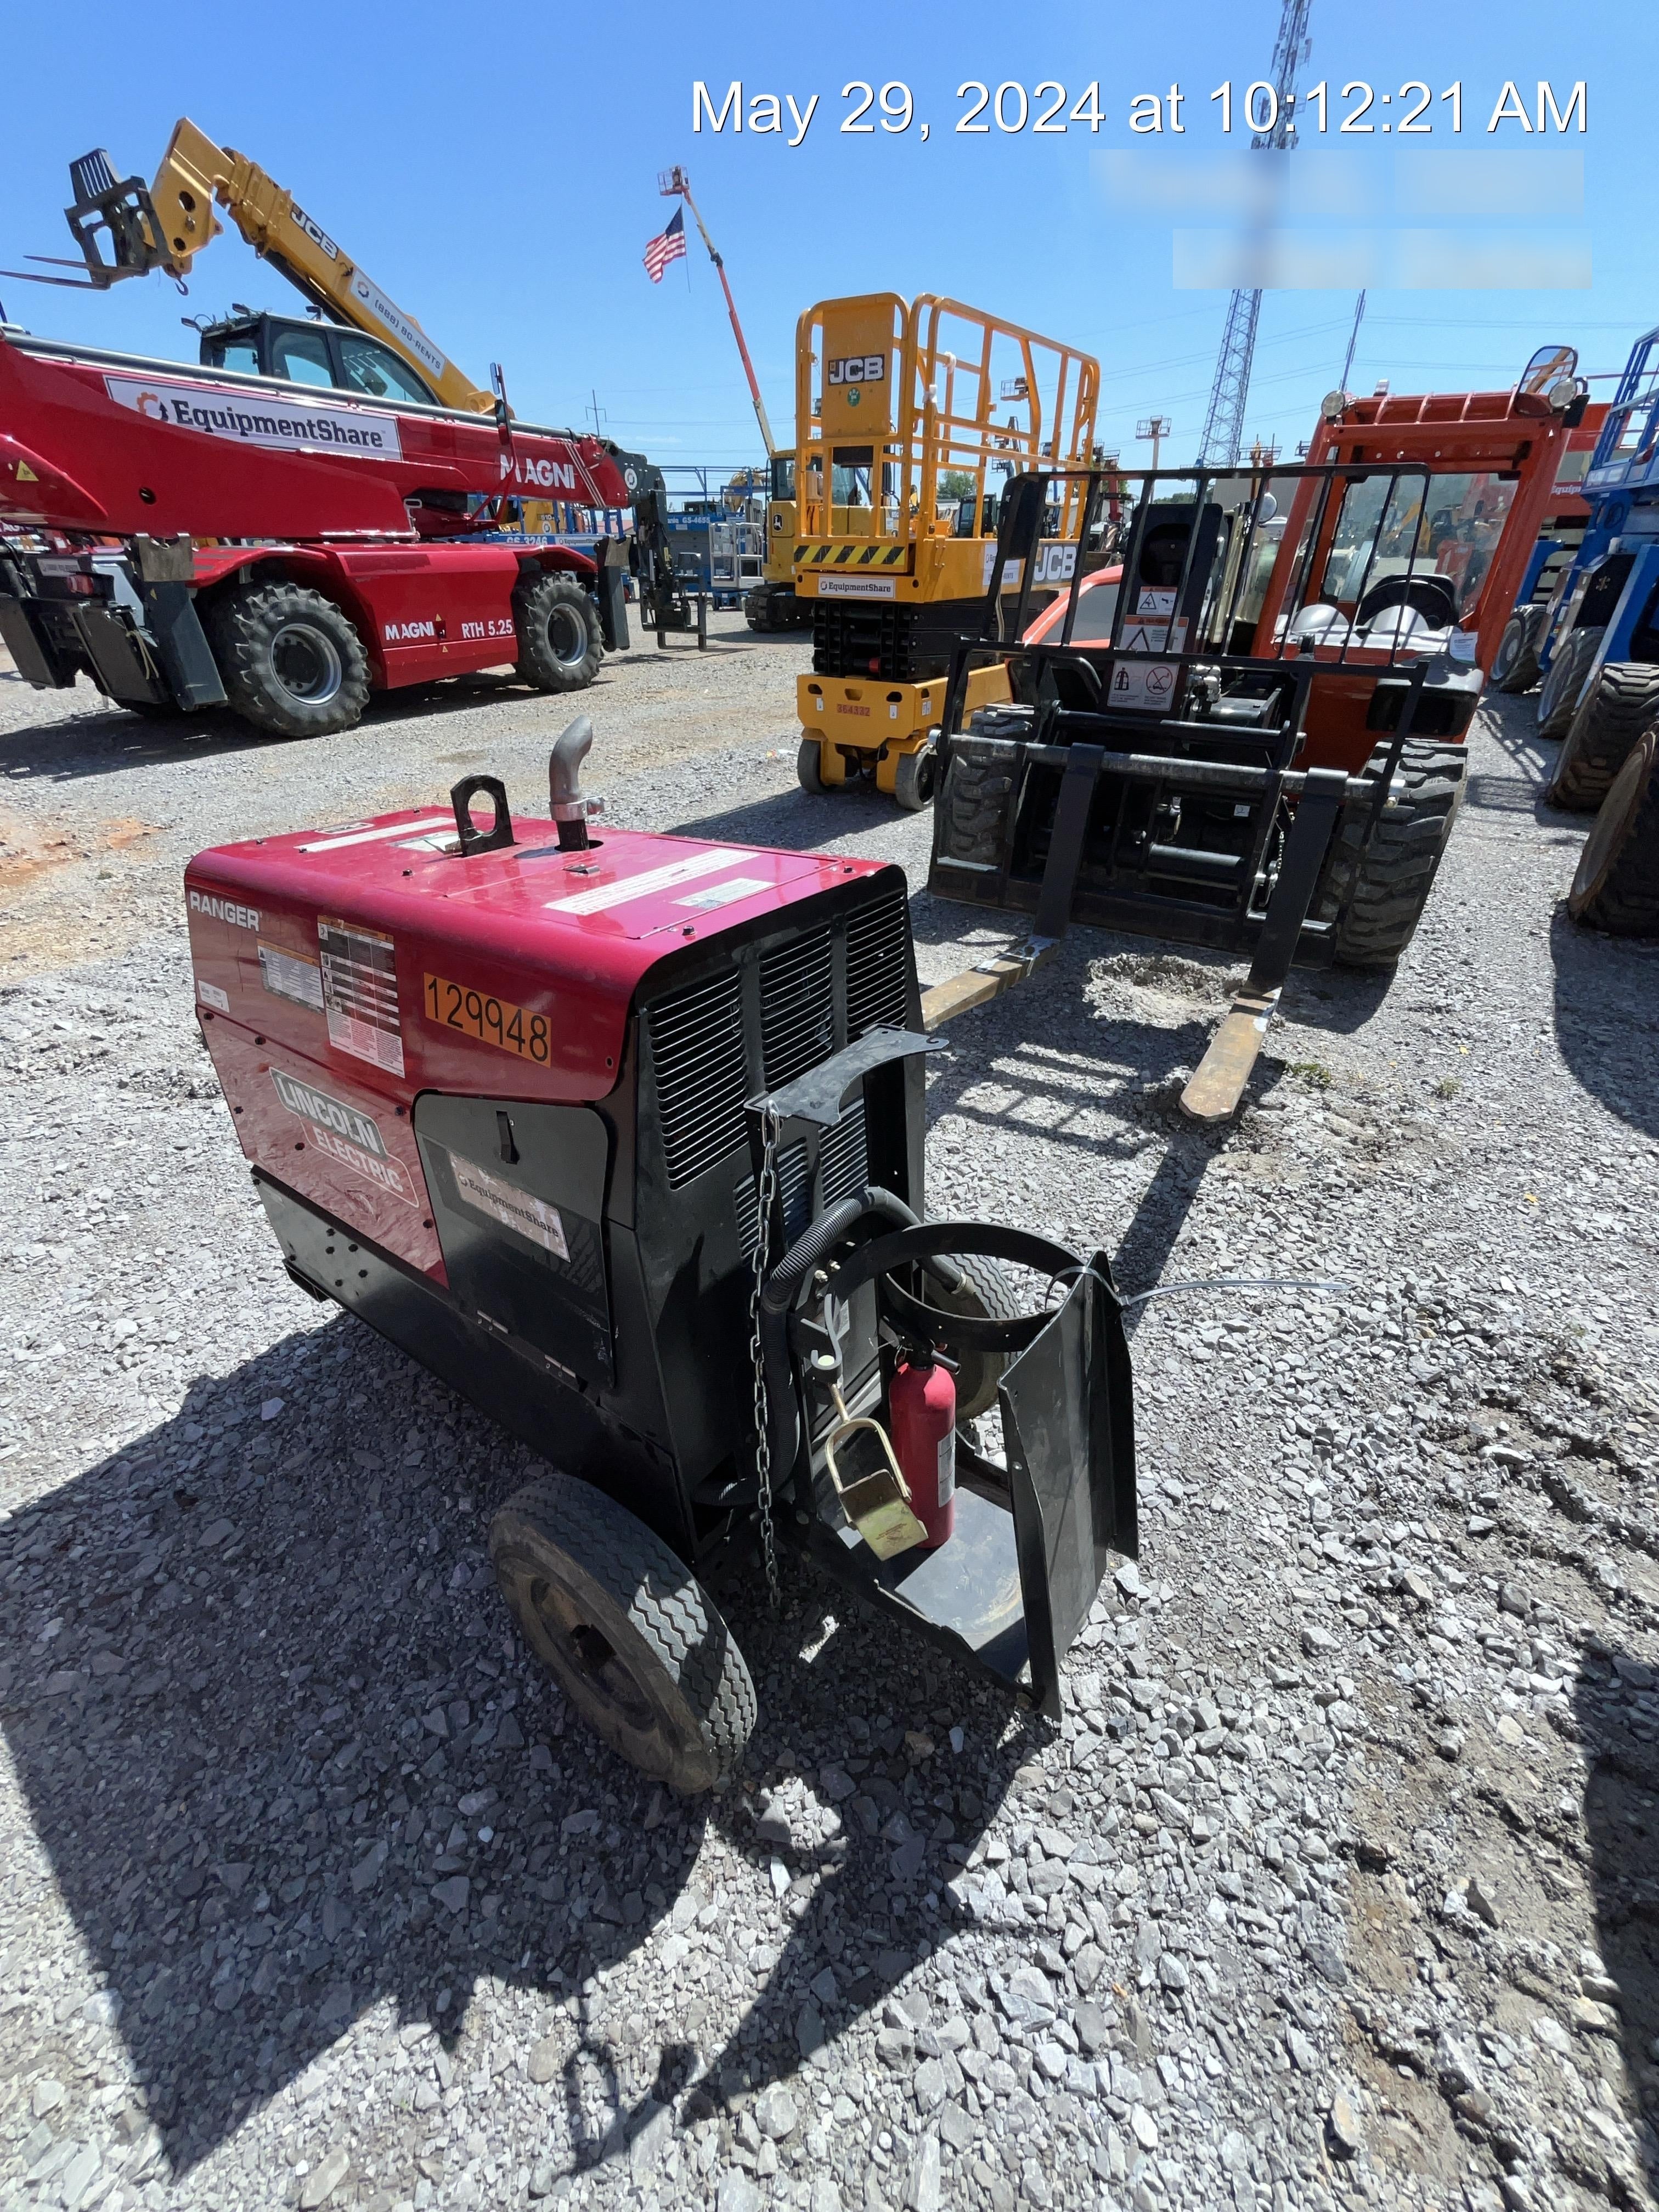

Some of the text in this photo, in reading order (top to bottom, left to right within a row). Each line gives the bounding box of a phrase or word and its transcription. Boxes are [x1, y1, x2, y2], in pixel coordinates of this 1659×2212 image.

[291, 211, 338, 259] JCB
[374, 298, 441, 370] (888) 80-RENTS
[829, 357, 884, 384] JCB
[171, 399, 384, 448] EquipmentShare
[500, 454, 575, 489] MAGNI
[1034, 545, 1077, 582] JCB
[828, 582, 891, 592] EquipmentShare
[385, 621, 435, 641] MAGNI
[461, 619, 513, 639] RTH 5.25
[189, 890, 260, 933] RANGER
[428, 977, 549, 1062] 129948
[276, 1076, 381, 1155] LINCOLN
[312, 1125, 404, 1193] ELECTRIC
[467, 1178, 560, 1238] EquipmentShare
